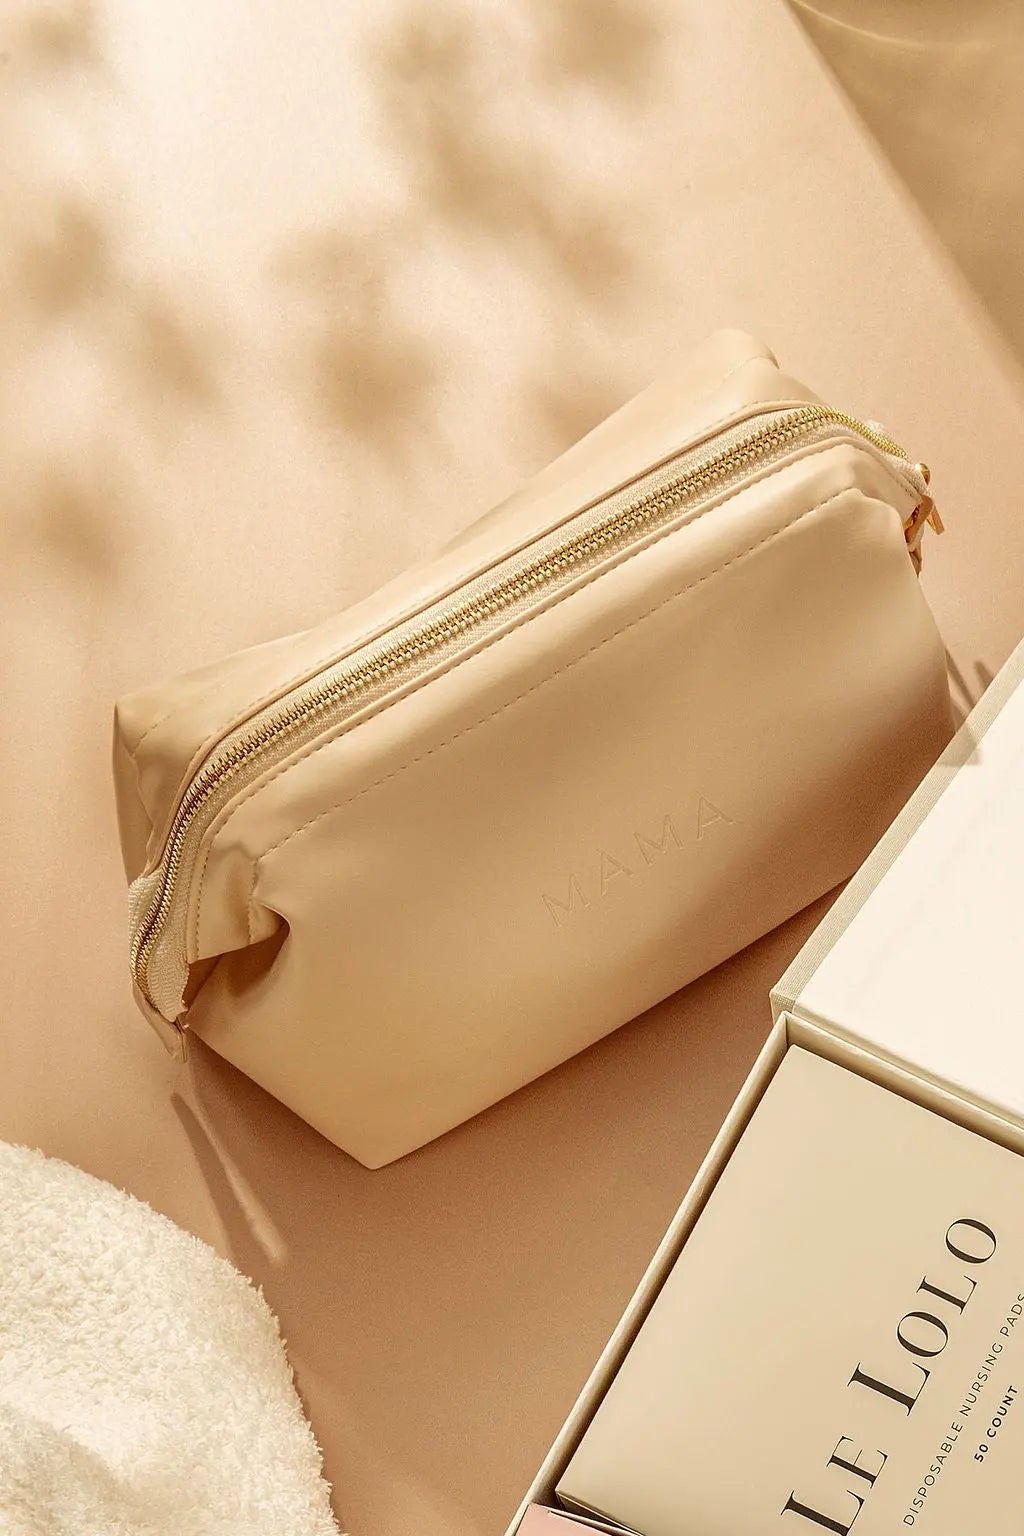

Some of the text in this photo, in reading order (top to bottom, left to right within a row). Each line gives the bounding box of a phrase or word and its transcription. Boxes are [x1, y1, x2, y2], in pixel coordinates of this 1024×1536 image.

[542, 796, 734, 927] MAMA
[847, 1217, 998, 1417] LOLO
[903, 1422, 963, 1526] DISPOSABLE
[959, 1343, 1002, 1416] NURSING
[974, 1386, 1017, 1462] 50 COUNT
